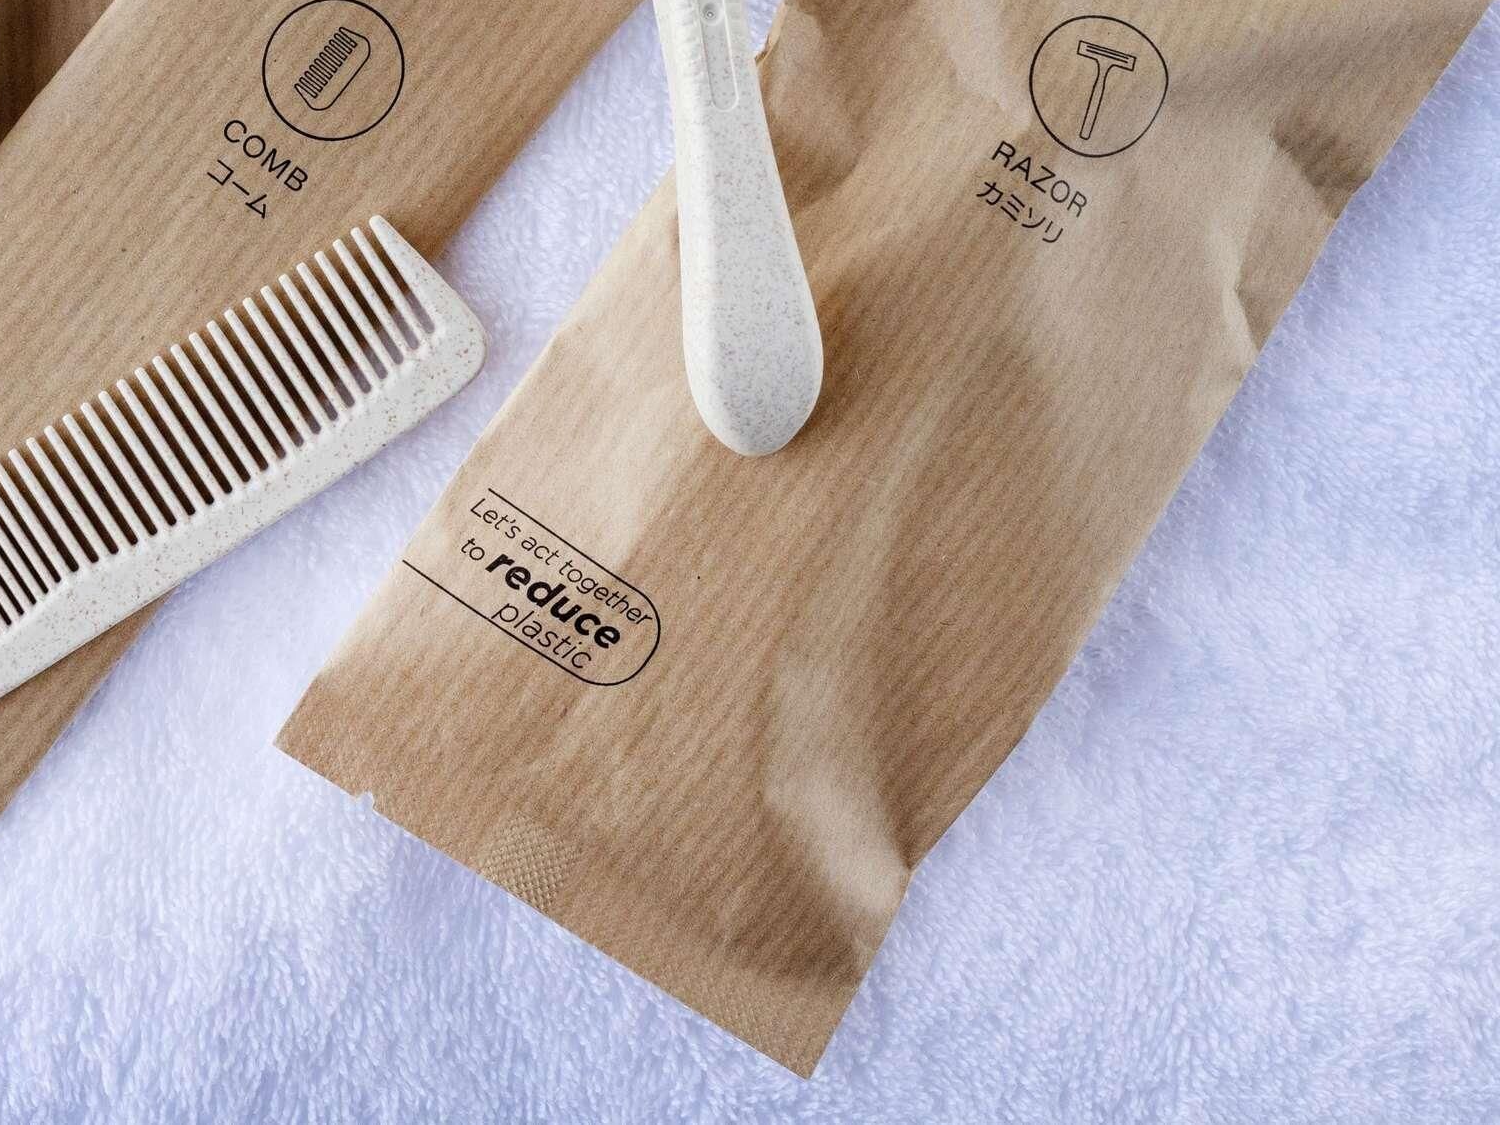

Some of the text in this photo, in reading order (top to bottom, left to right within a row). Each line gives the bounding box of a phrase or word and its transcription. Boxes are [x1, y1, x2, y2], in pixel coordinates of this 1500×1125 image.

[207, 159, 268, 219] コーム
[223, 119, 308, 192] COMB
[991, 140, 1088, 218] RAZOR
[976, 181, 1064, 244] カミソリ
[460, 537, 621, 649] to reduce
[470, 498, 653, 625] Let's act together
[491, 602, 592, 669] plastic
